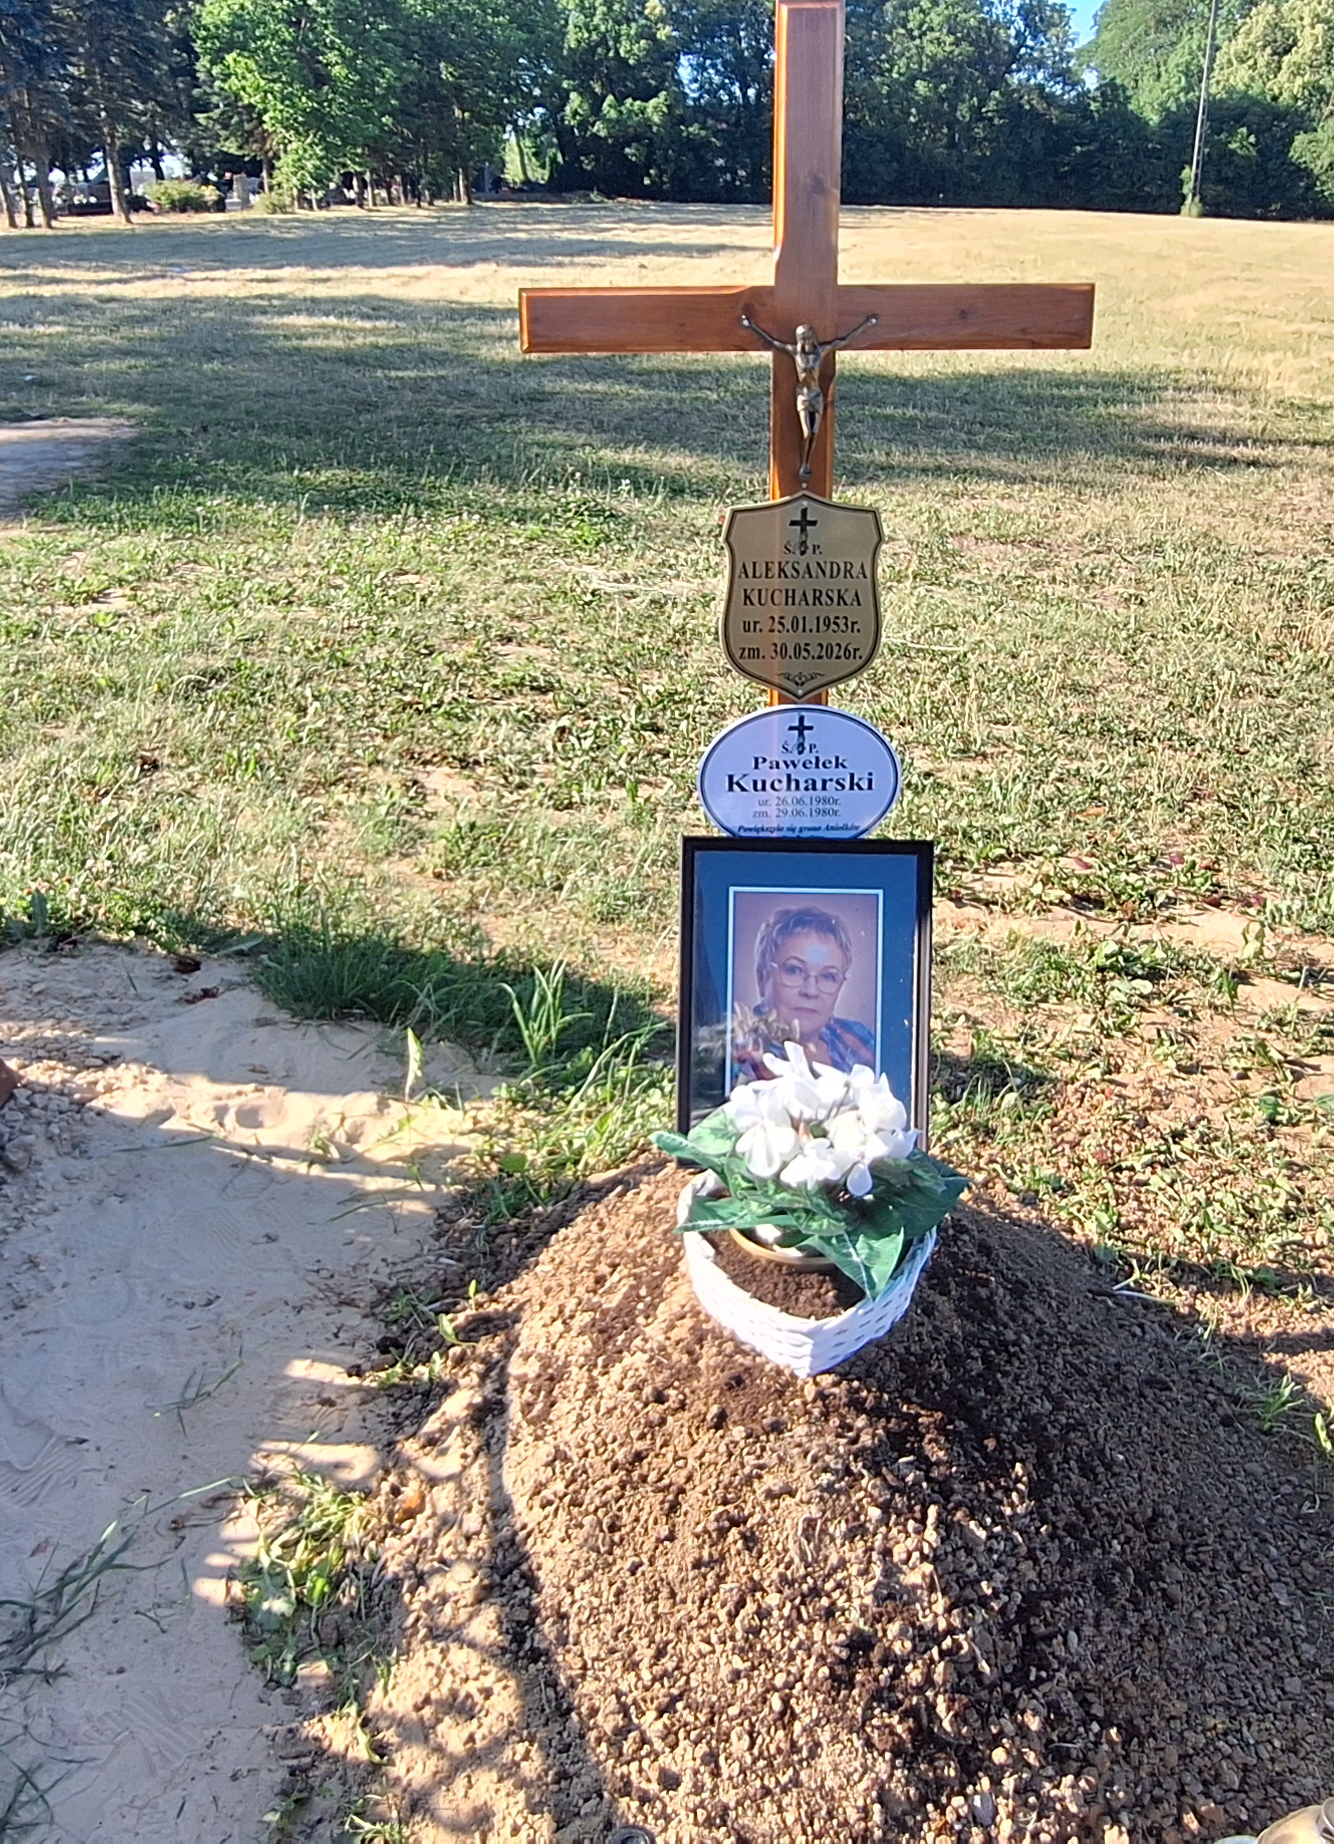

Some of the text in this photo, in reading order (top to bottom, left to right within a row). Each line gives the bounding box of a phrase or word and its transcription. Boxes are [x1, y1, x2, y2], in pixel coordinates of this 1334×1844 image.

[812, 544, 823, 555] P.
[738, 561, 868, 580] ALEKSANDRA
[742, 588, 862, 607] KUCHARSKA
[742, 615, 861, 634] ur. 25.01.1953r.
[738, 642, 863, 660] zm. 30.05.2026r.
[808, 743, 819, 754] P.
[751, 756, 849, 770] Pawełek
[725, 772, 874, 792] Kucharski
[757, 796, 841, 807] ur. 26.06.1980r.
[775, 808, 841, 818] 29.06.1980r.
